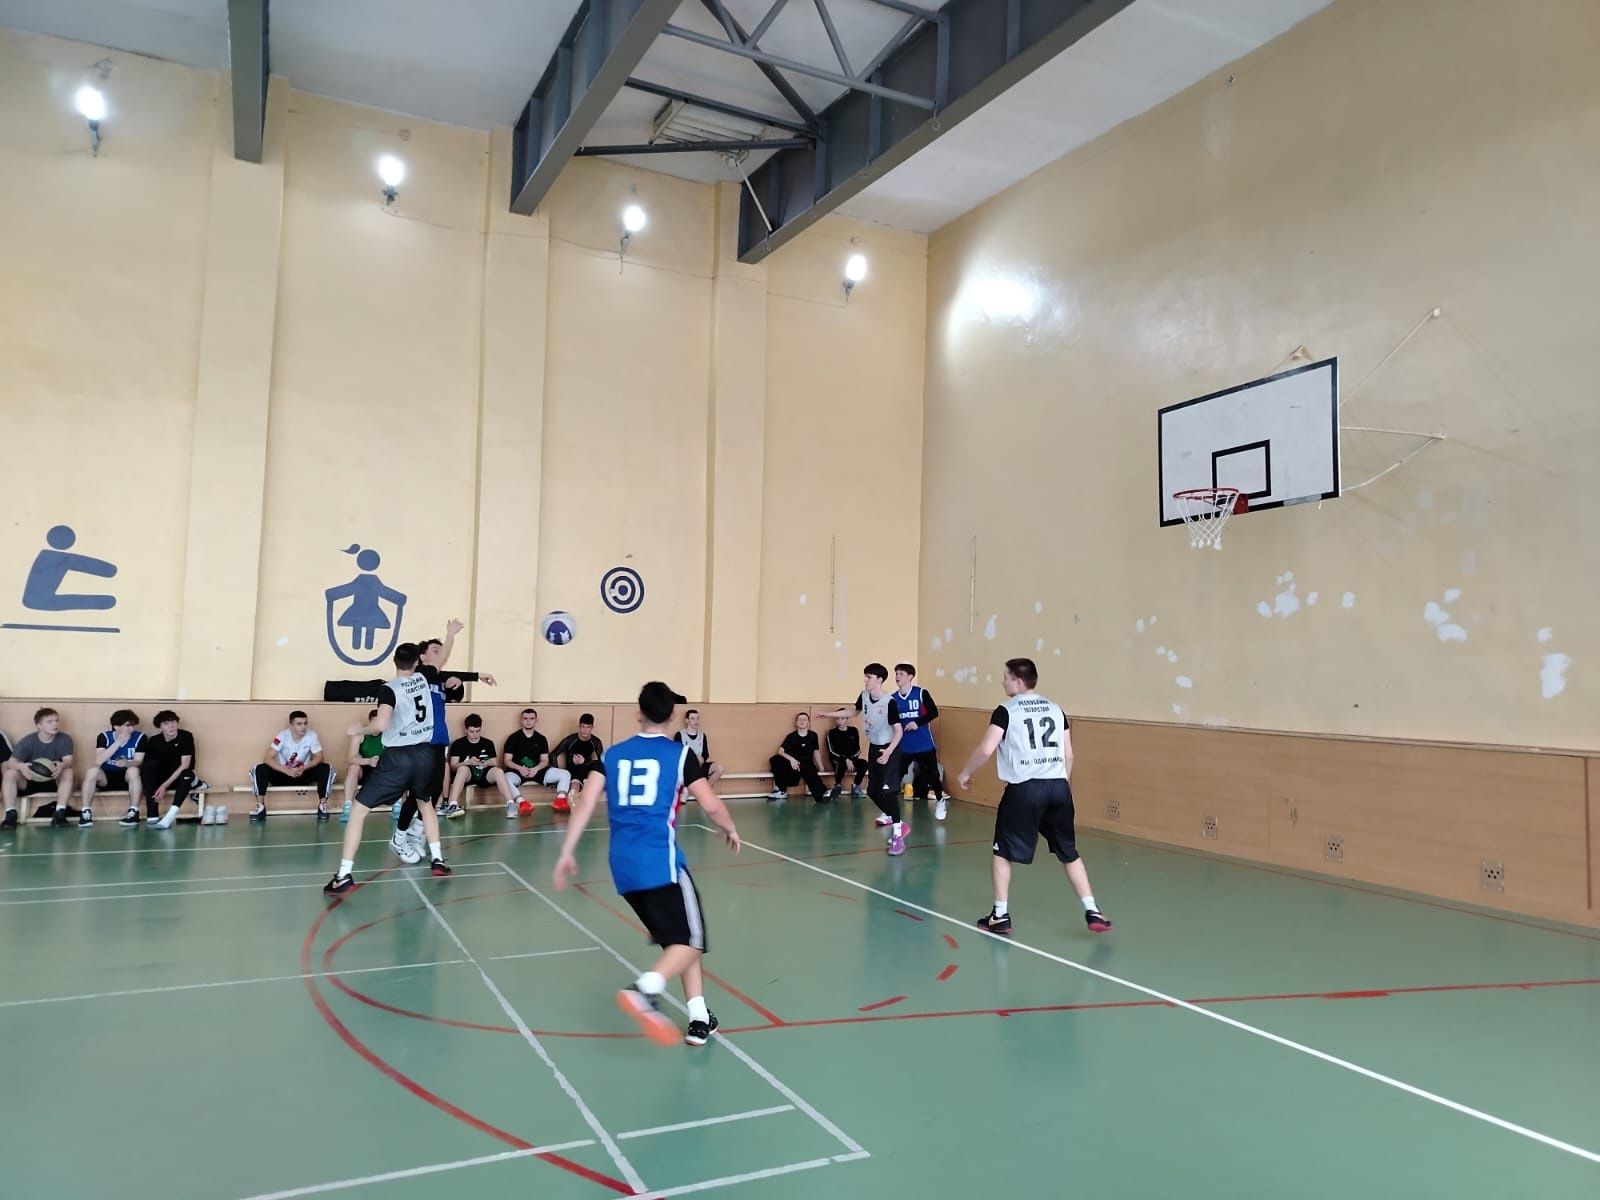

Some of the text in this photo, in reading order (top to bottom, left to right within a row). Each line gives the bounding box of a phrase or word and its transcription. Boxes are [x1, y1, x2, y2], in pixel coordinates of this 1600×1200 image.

[413, 694, 427, 723] 5
[908, 699, 920, 711] 10
[1023, 716, 1059, 750] 12
[617, 758, 661, 807] 13
